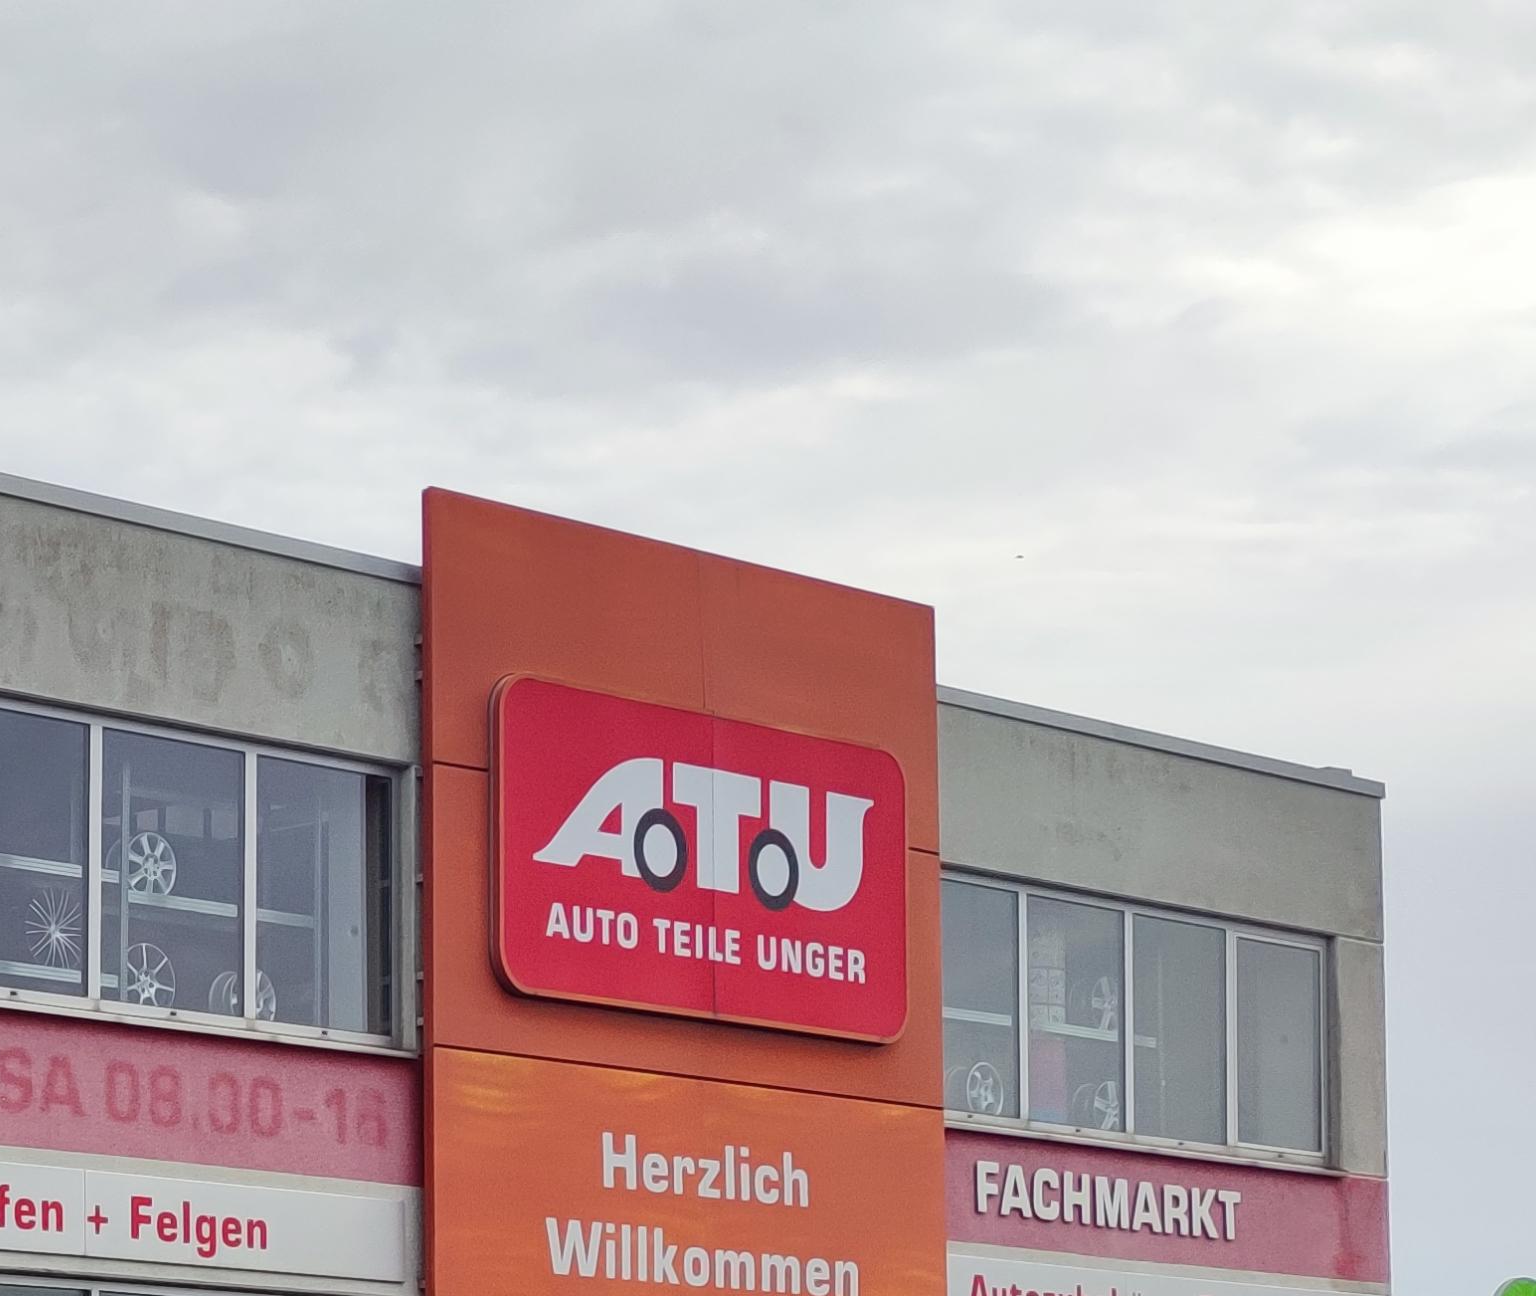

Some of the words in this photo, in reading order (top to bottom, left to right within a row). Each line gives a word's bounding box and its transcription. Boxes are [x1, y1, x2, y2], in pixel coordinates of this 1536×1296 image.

[546, 902, 638, 949] AUTO
[653, 918, 741, 965] TEILE
[757, 934, 866, 985] UNGER
[601, 1131, 809, 1208] Herzlich
[974, 1160, 1242, 1241] FACHMARKT
[87, 1204, 109, 1235] +
[130, 1195, 268, 1259] Felgen
